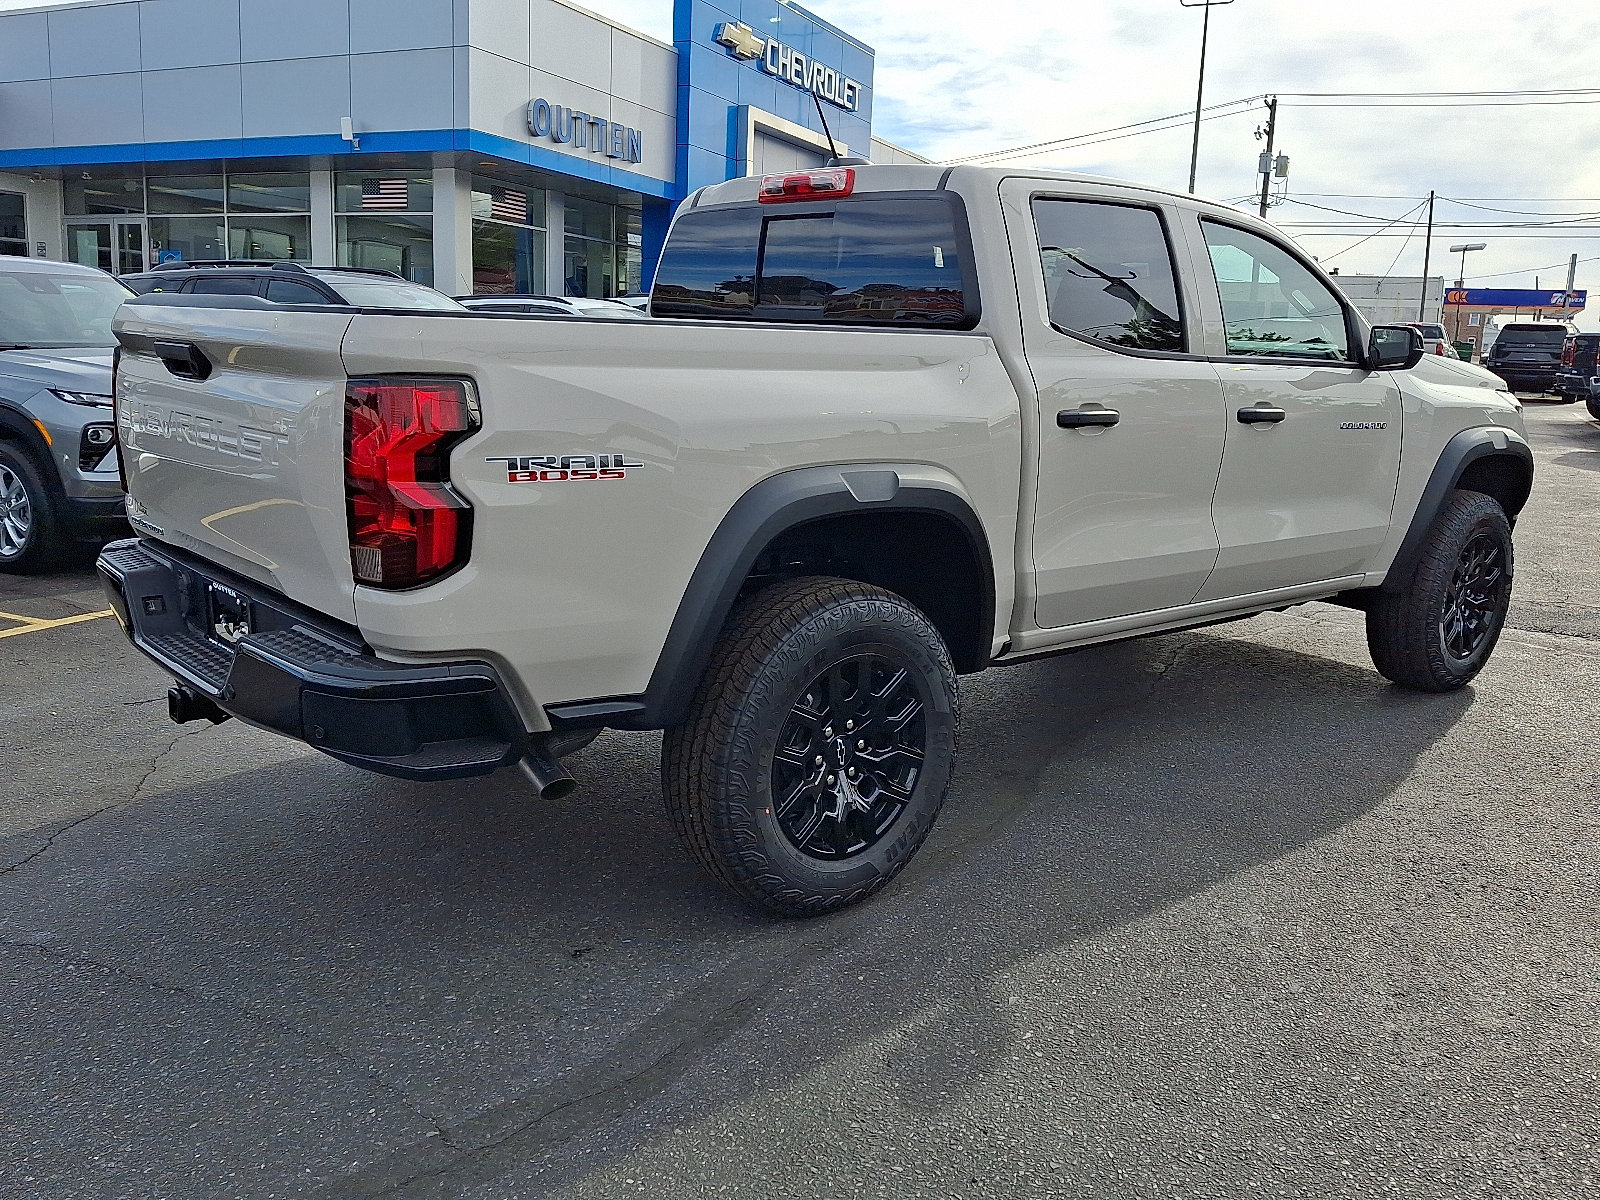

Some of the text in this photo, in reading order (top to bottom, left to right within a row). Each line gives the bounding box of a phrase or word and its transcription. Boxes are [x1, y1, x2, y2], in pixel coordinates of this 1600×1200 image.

[764, 38, 862, 112] CHEVROLET
[527, 97, 643, 164] OUTTEN
[485, 454, 645, 471] TRAIL
[507, 468, 627, 484] BOSS
